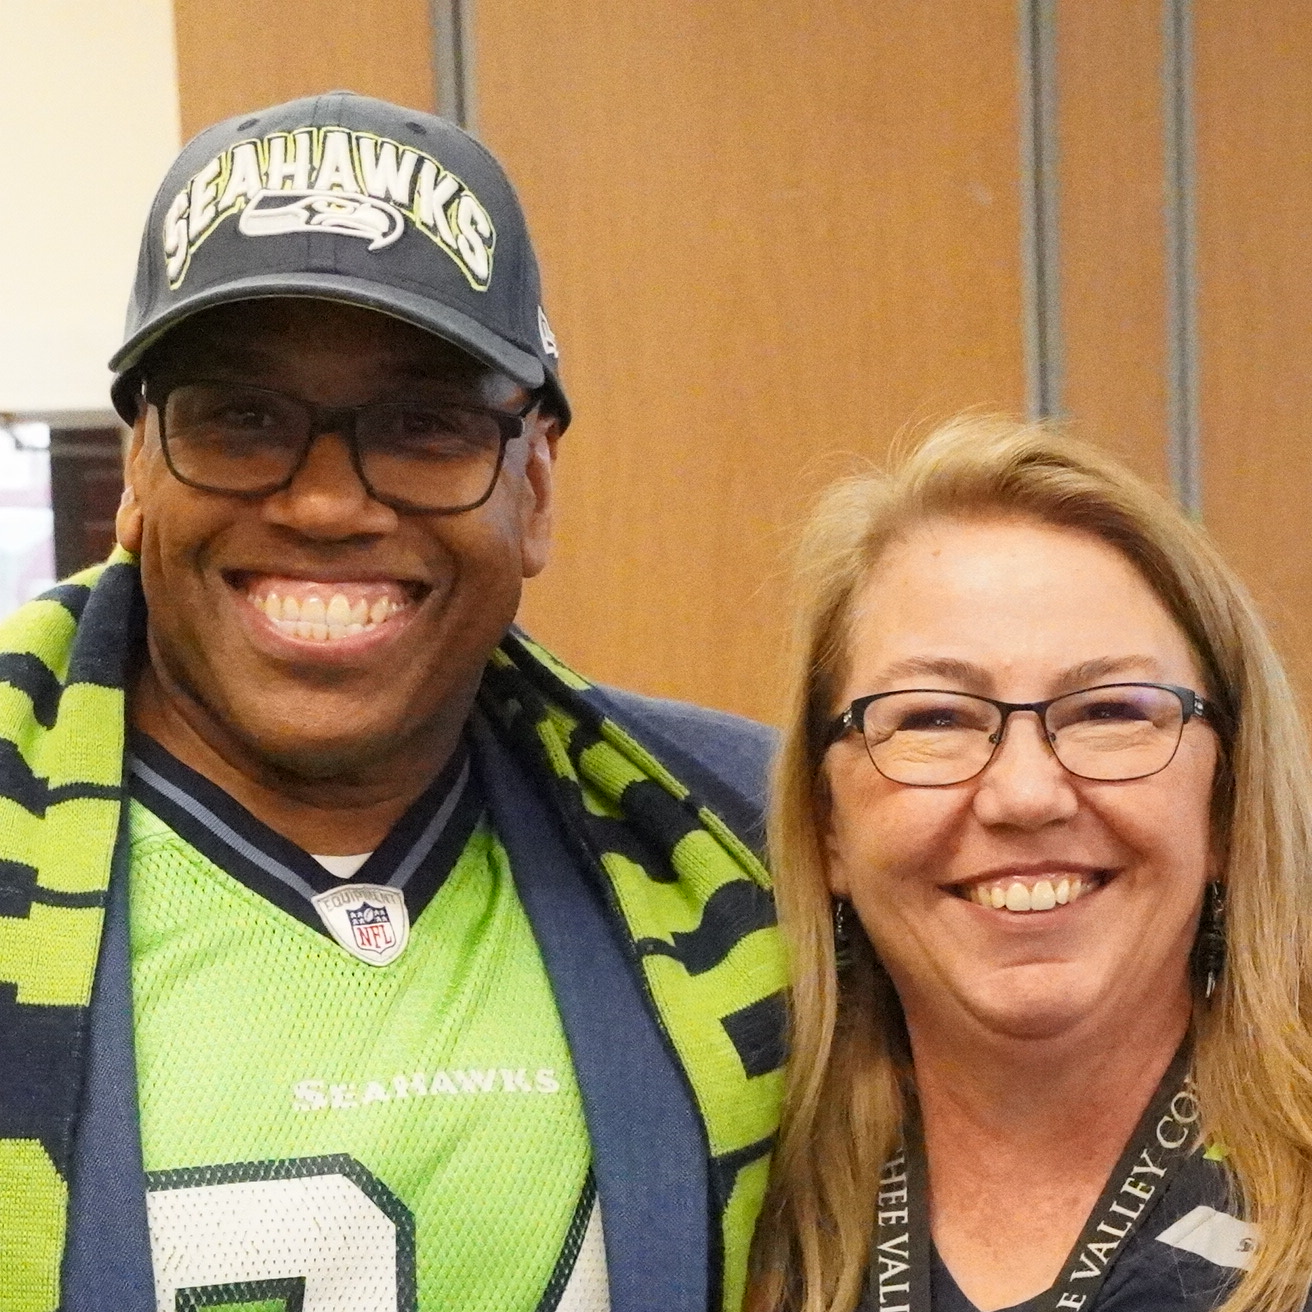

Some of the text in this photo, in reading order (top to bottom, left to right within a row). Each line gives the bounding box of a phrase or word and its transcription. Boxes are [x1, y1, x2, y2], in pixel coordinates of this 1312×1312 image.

[163, 128, 495, 290] SEAHAWKS
[324, 887, 397, 911] EQUIPMENT
[357, 924, 392, 949] NFL
[1072, 1149, 1167, 1282] VALLEY
[1156, 1074, 1200, 1150] CO
